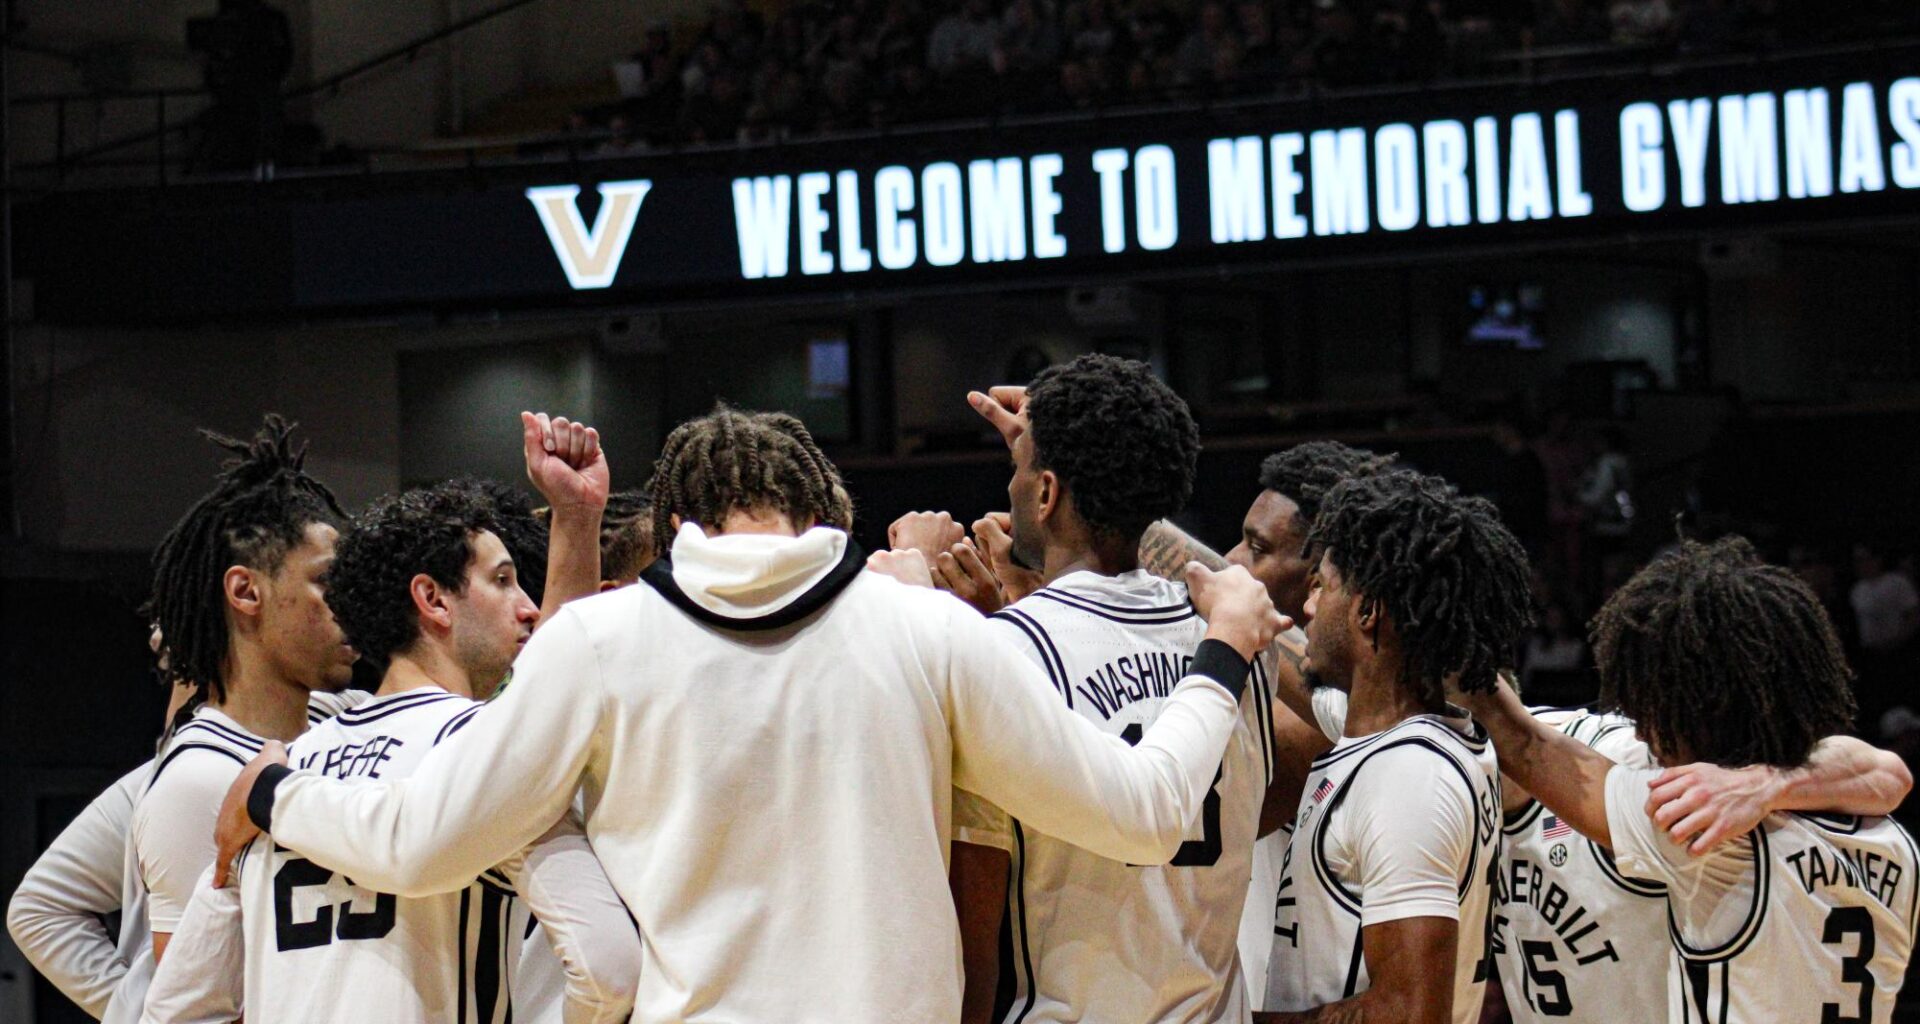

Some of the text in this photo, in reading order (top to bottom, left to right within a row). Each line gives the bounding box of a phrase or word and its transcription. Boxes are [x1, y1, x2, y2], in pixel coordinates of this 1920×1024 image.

[731, 77, 1920, 279] WELCOME TO MEMORIAL GYMNAS
[526, 179, 652, 290] V
[1785, 845, 1903, 909] TANNER
[1516, 938, 1574, 1017] 5
[1821, 905, 1876, 1024] 3
